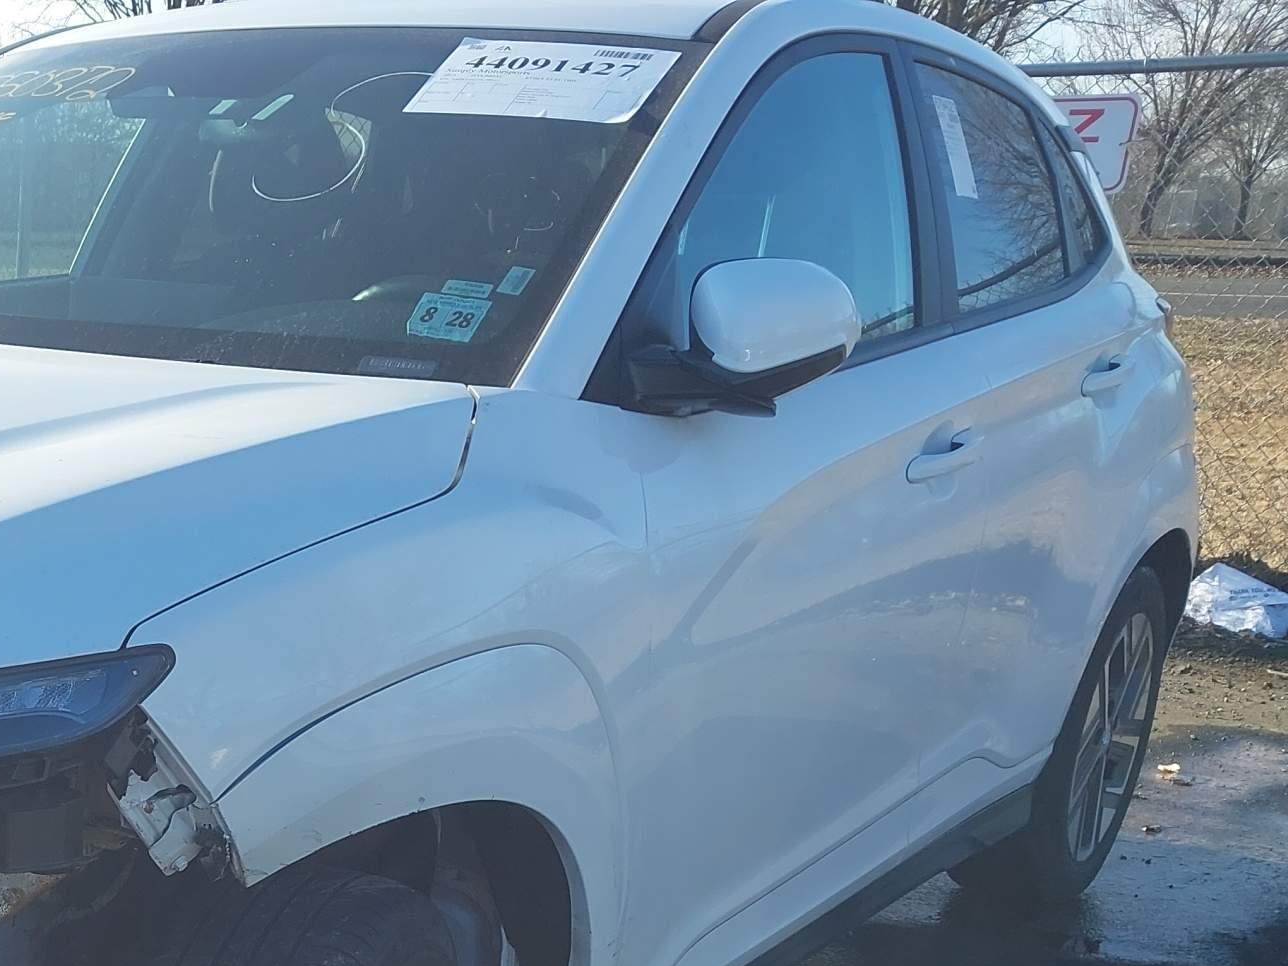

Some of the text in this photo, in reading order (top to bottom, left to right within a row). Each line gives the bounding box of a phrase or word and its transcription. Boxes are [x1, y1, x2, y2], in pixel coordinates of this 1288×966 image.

[465, 54, 640, 79] 44091427
[419, 306, 475, 329] 8 28
